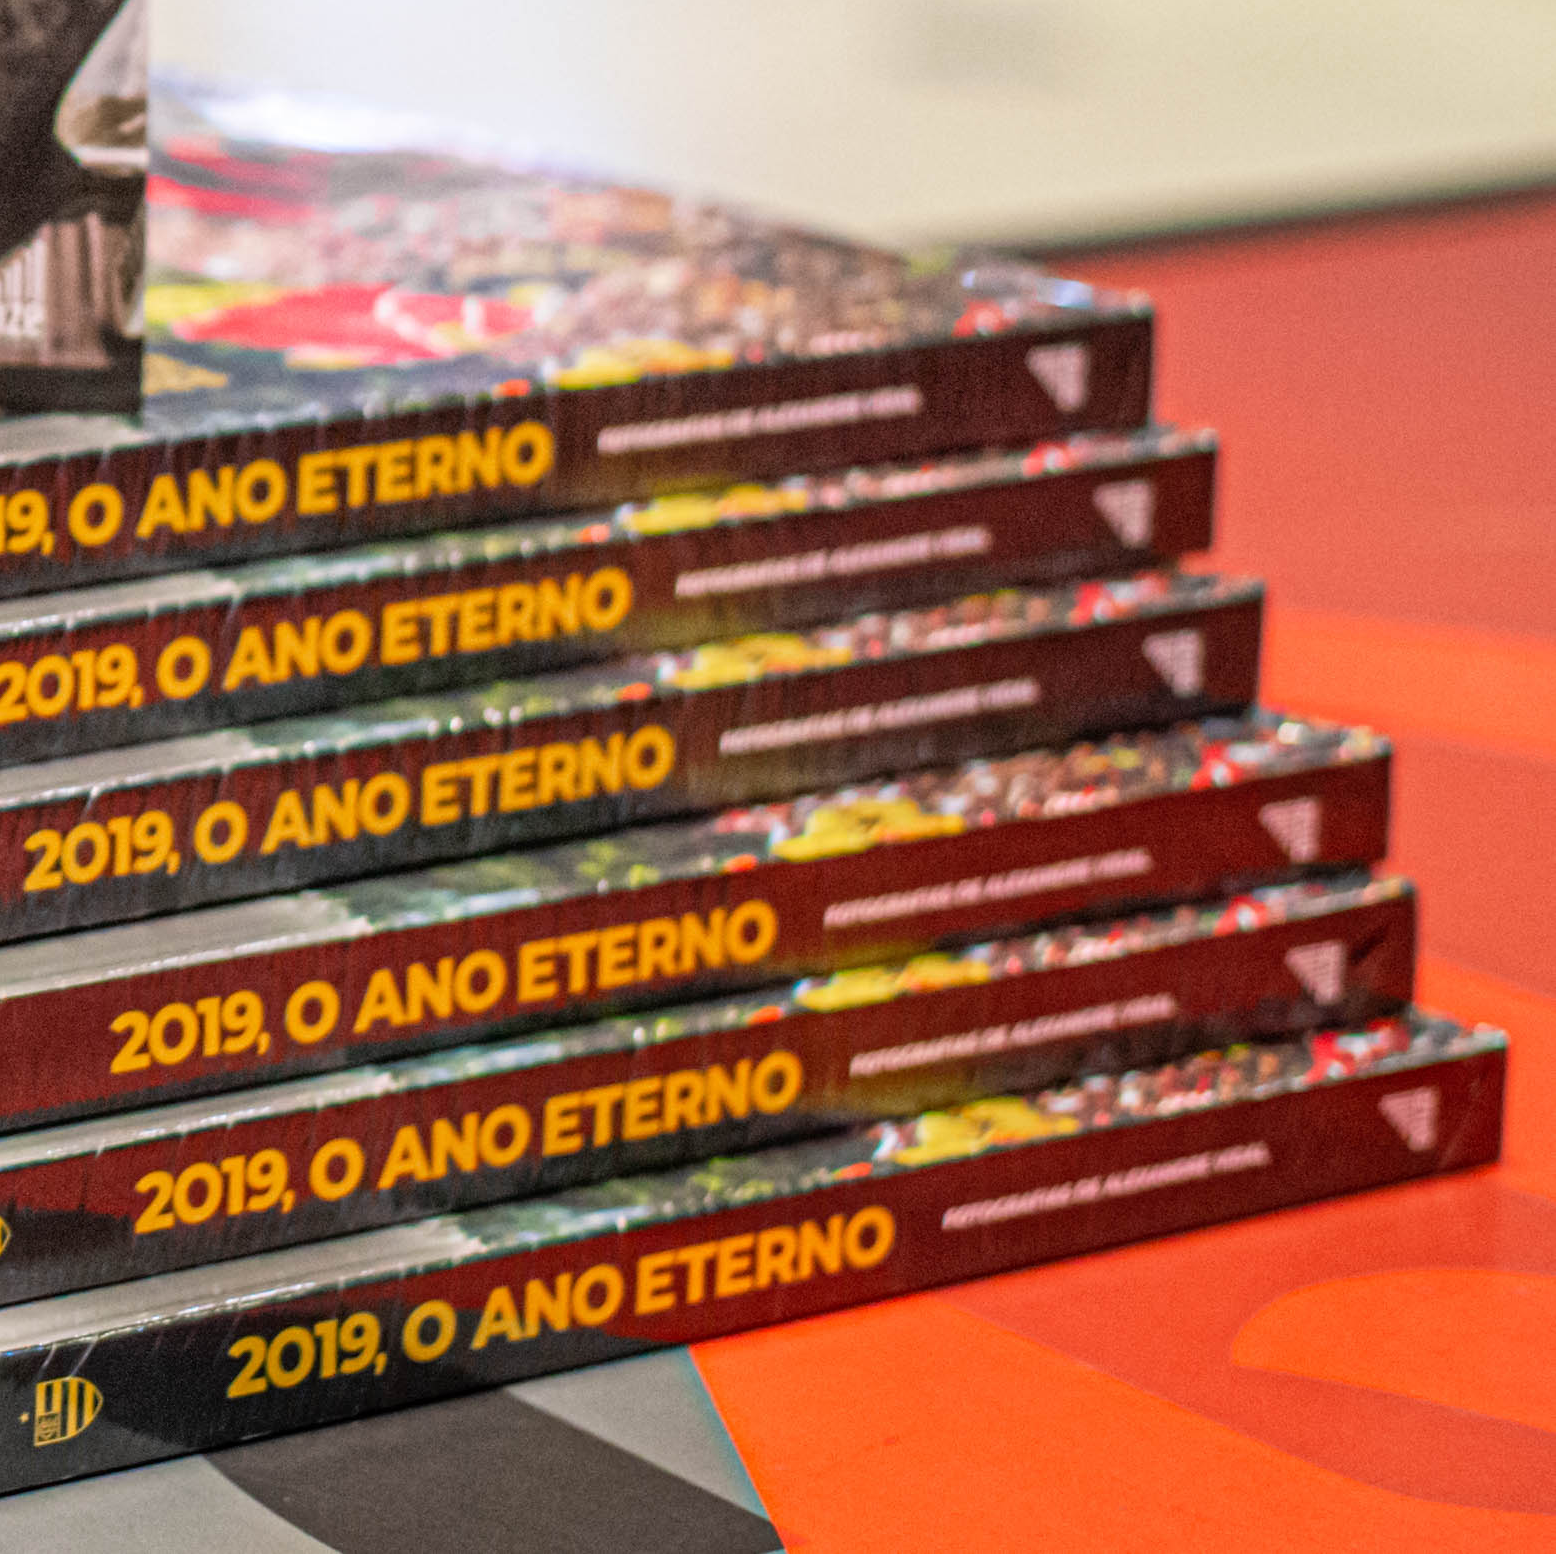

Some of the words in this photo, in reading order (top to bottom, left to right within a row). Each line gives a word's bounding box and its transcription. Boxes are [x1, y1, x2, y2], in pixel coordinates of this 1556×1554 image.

[66, 482, 124, 547] O
[134, 458, 289, 540] ANO
[295, 420, 556, 516] ETERNO
[155, 634, 212, 699] O
[222, 608, 374, 693] ANO
[379, 565, 636, 666] ETERNO
[22, 809, 182, 893] 2019,
[191, 799, 250, 865] O
[259, 770, 413, 856] ANO
[419, 723, 677, 827] ETERNO
[110, 989, 272, 1075] 2019,
[283, 978, 341, 1046] O
[352, 949, 508, 1035] ANO
[516, 898, 778, 1003] ETERNO
[134, 1146, 296, 1234] 2019,
[307, 1136, 366, 1202] O
[376, 1103, 533, 1191] ANO
[542, 1048, 805, 1157] ETERNO
[227, 1312, 387, 1399] 2019,
[403, 1298, 457, 1361] O
[471, 1263, 625, 1350] ANO
[634, 1205, 896, 1316] ETERNO
